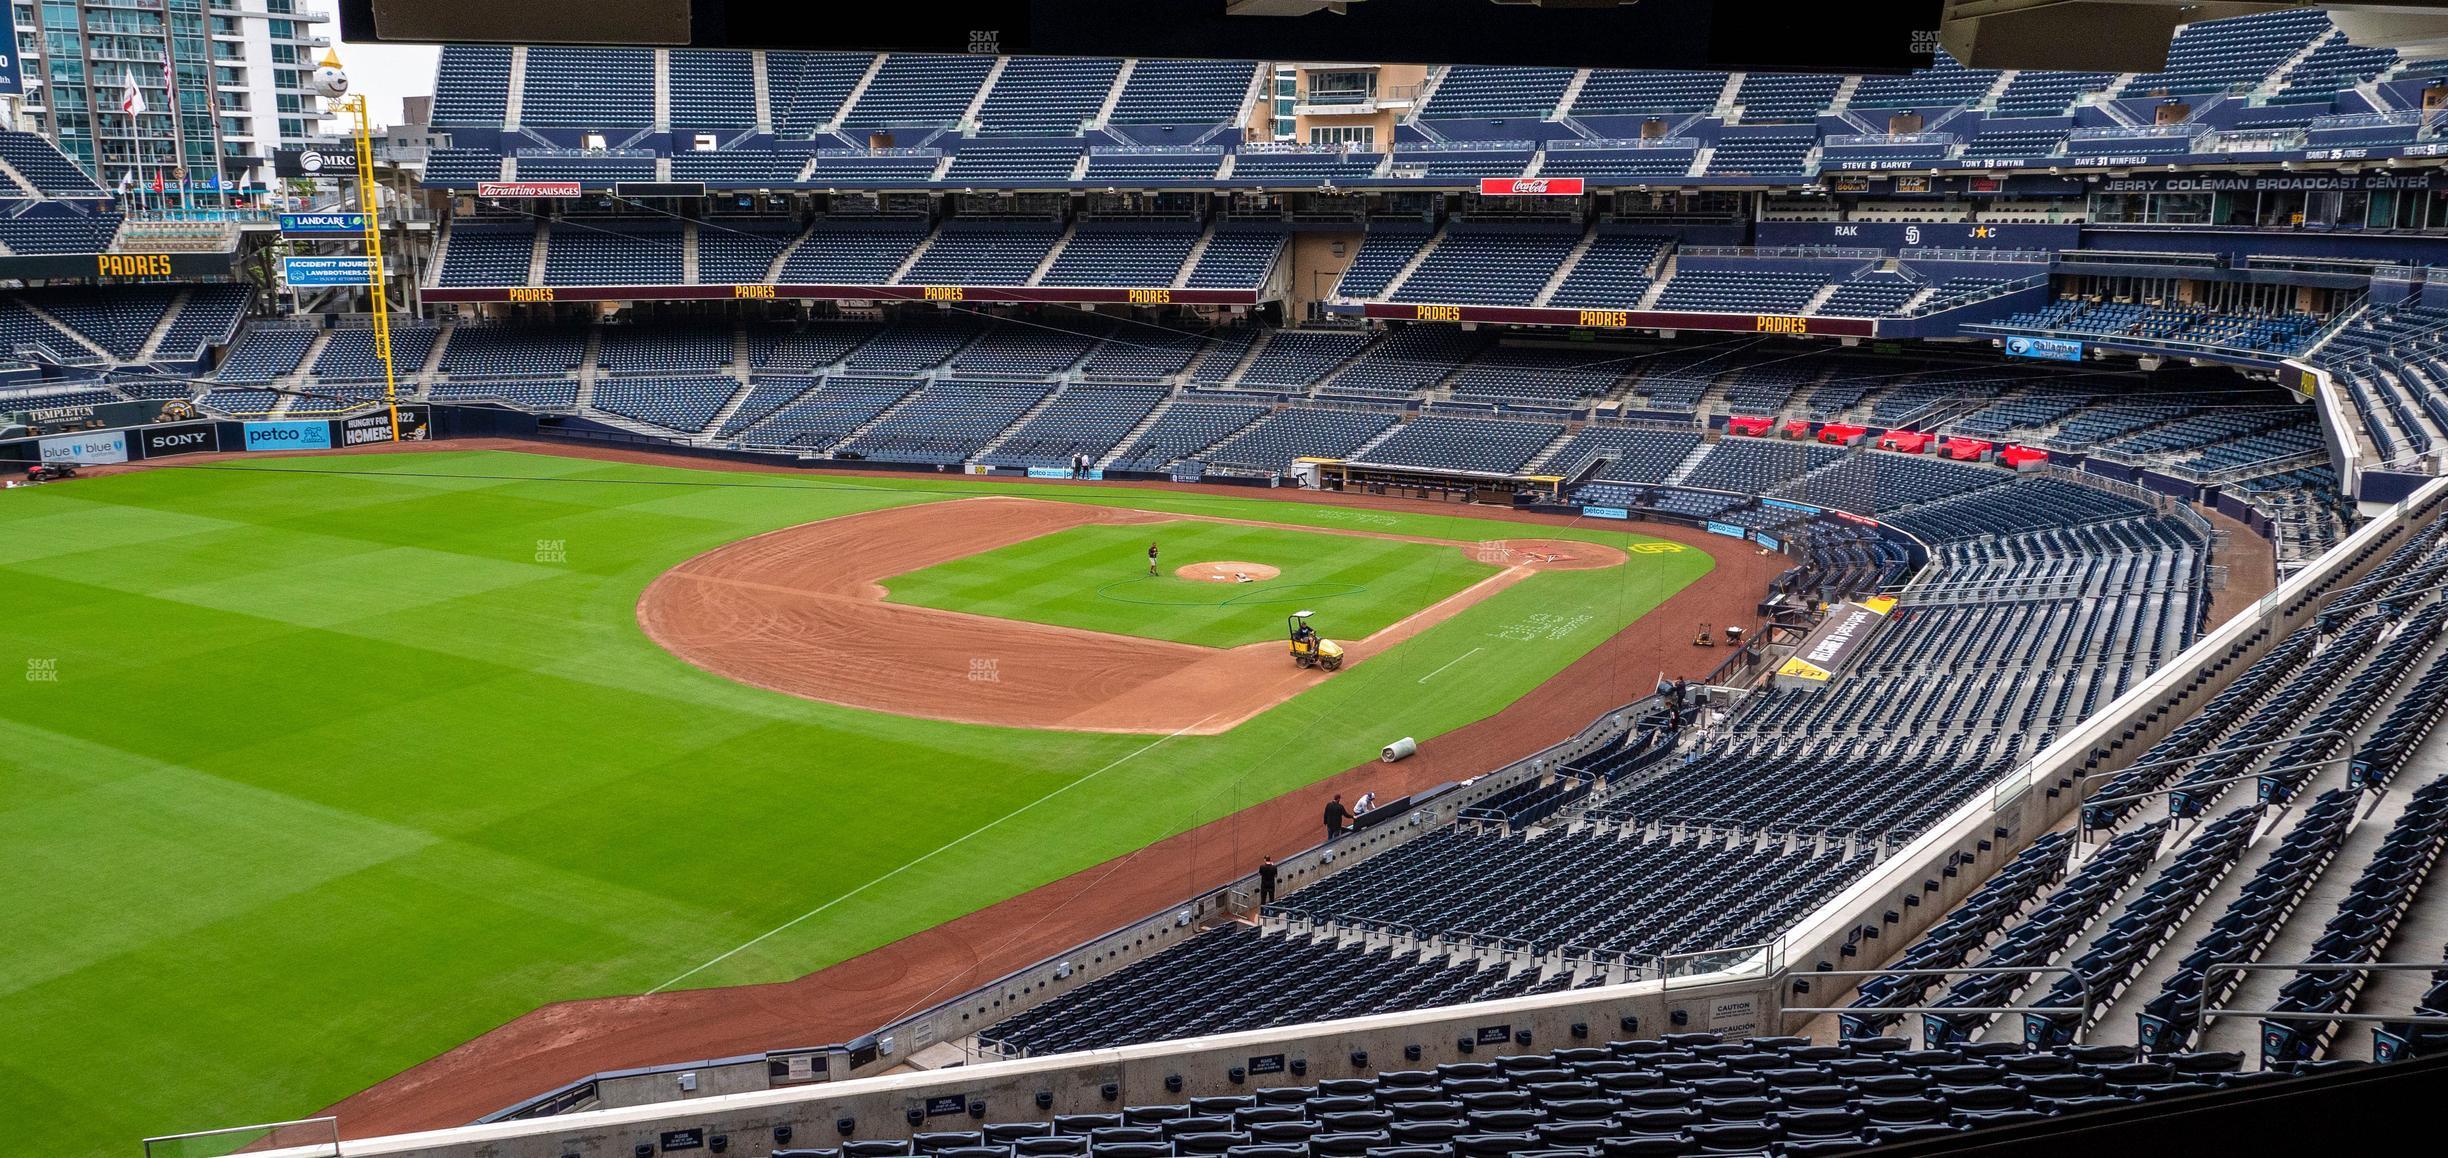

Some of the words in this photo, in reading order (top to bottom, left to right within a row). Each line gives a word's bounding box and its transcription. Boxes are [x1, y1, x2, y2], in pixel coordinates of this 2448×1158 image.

[2330, 149, 2343, 159] 35
[322, 155, 356, 166] MRC
[1870, 161, 1877, 169] 6
[1984, 159, 1994, 168] 19
[1996, 159, 2024, 167] GWYNN
[2075, 158, 2095, 166] DAVE
[2097, 157, 2107, 166] 31
[2109, 156, 2147, 165] WINFIELD
[1512, 179, 1549, 193] Coca-Cola
[2105, 180, 2159, 191] JERRY
[2166, 178, 2249, 191] COLEMAN
[2255, 177, 2359, 190] BROADCAST
[2365, 176, 2430, 189] CENTER
[481, 184, 536, 196] Tarantino
[537, 187, 579, 196] SAUSAGES
[297, 216, 345, 226] LANDCARE
[1835, 226, 1858, 235] RAK
[97, 255, 172, 276] PADRES
[510, 288, 554, 301] PADRES
[735, 286, 775, 298] PADRES
[924, 287, 963, 300] PADRES
[1129, 290, 1169, 303] PADRES
[1417, 305, 1460, 320] PADRES
[1580, 311, 1627, 326] PADRES
[1756, 316, 1807, 333] PADRES
[30, 406, 94, 421] TEMPLETON
[44, 416, 82, 424] DISTILLERY
[348, 417, 374, 428] HUNGRY
[375, 416, 389, 425] FOR
[152, 433, 206, 448] SONY
[250, 428, 299, 444] petco
[346, 425, 393, 444] HOMERS
[44, 447, 70, 458] blue
[85, 442, 112, 453] blue
[1584, 507, 1605, 515] petco
[1709, 522, 1727, 532] petco
[1717, 1002, 1750, 1012] CAUTION
